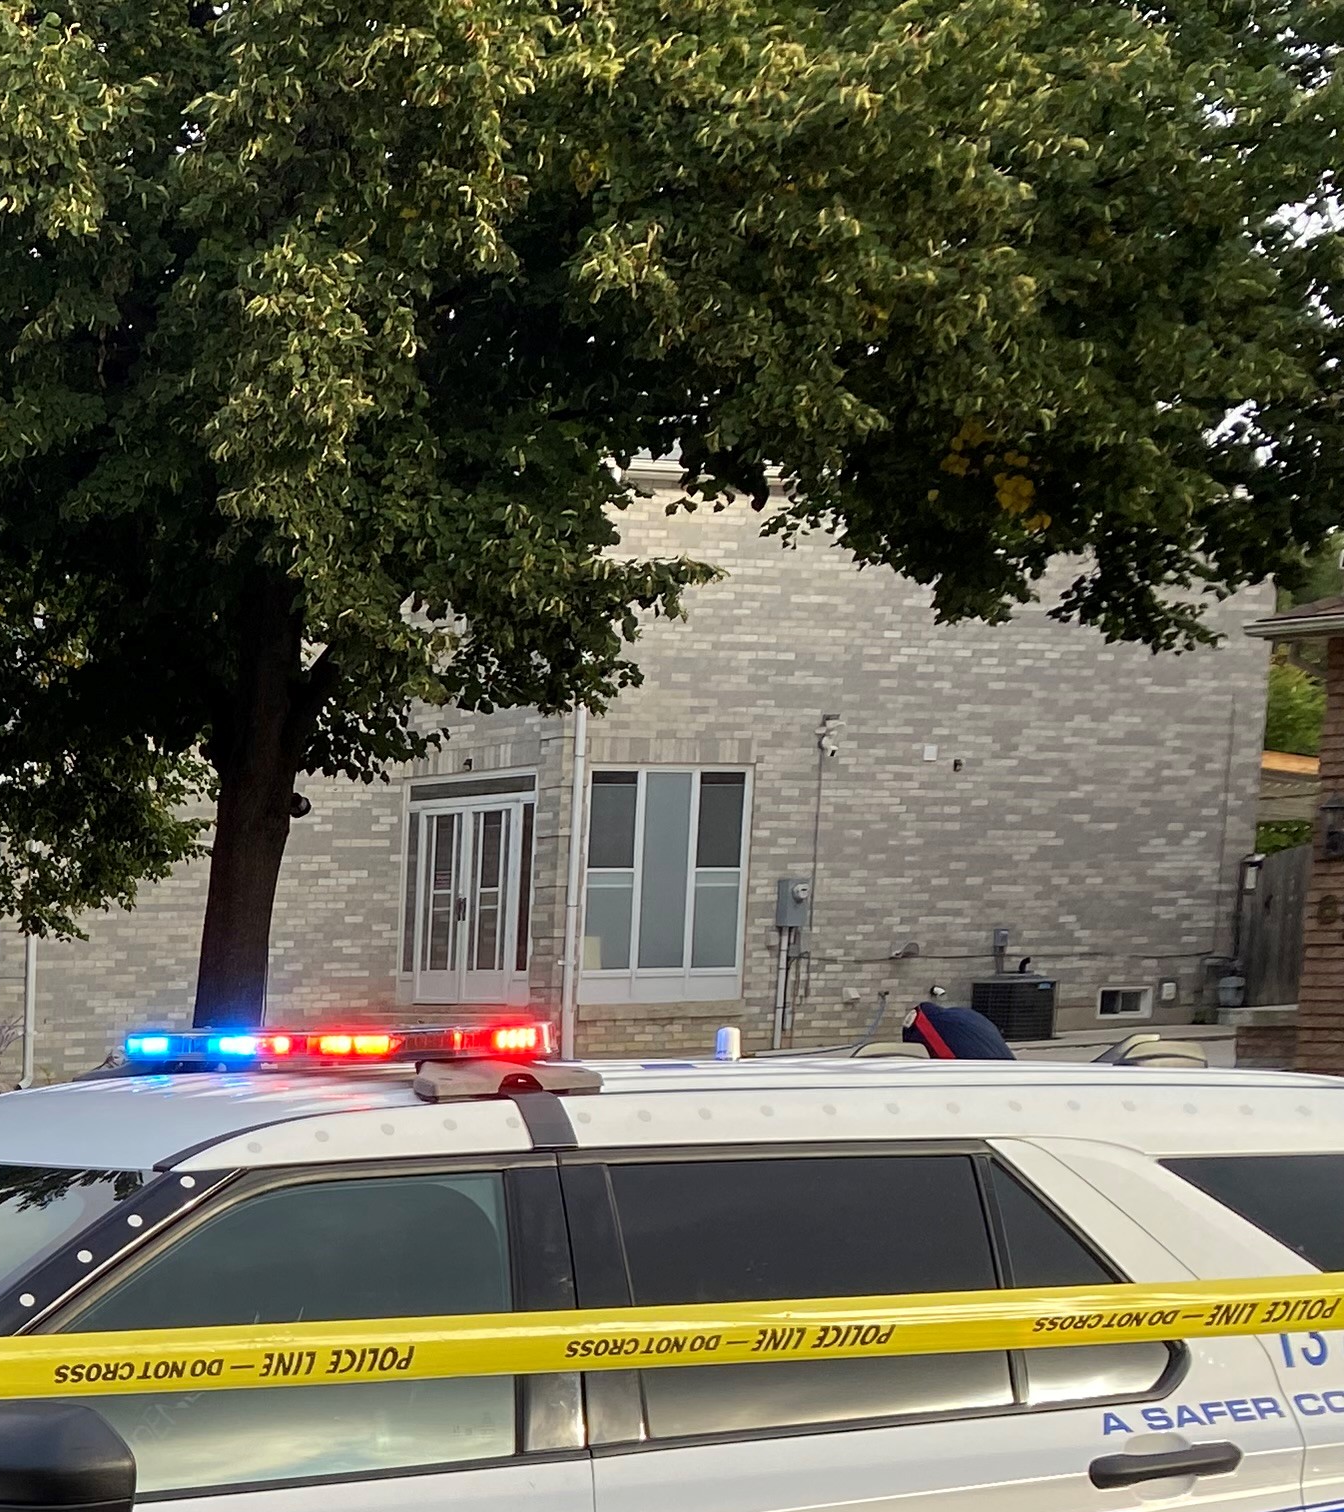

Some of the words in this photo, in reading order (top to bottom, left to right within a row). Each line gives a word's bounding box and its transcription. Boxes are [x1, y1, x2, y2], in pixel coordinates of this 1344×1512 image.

[1102, 1311, 1148, 1329] NOT
[1147, 1309, 1182, 1327] DO
[1203, 1302, 1260, 1327] LINE
[1260, 1297, 1343, 1324] POLICE
[1031, 1313, 1105, 1333] CROSS
[640, 1336, 688, 1355] NOT
[689, 1334, 723, 1352] DO
[750, 1327, 807, 1352] LINE
[811, 1324, 897, 1349] POLICE
[563, 1337, 640, 1359] CROSS
[140, 1360, 189, 1380] NOT
[189, 1358, 225, 1378] DO
[258, 1351, 318, 1378] LINE
[324, 1345, 416, 1374] POLICE
[53, 1362, 134, 1384] CROSS
[1103, 1412, 1134, 1436] A
[1140, 1397, 1287, 1432] SAFER
